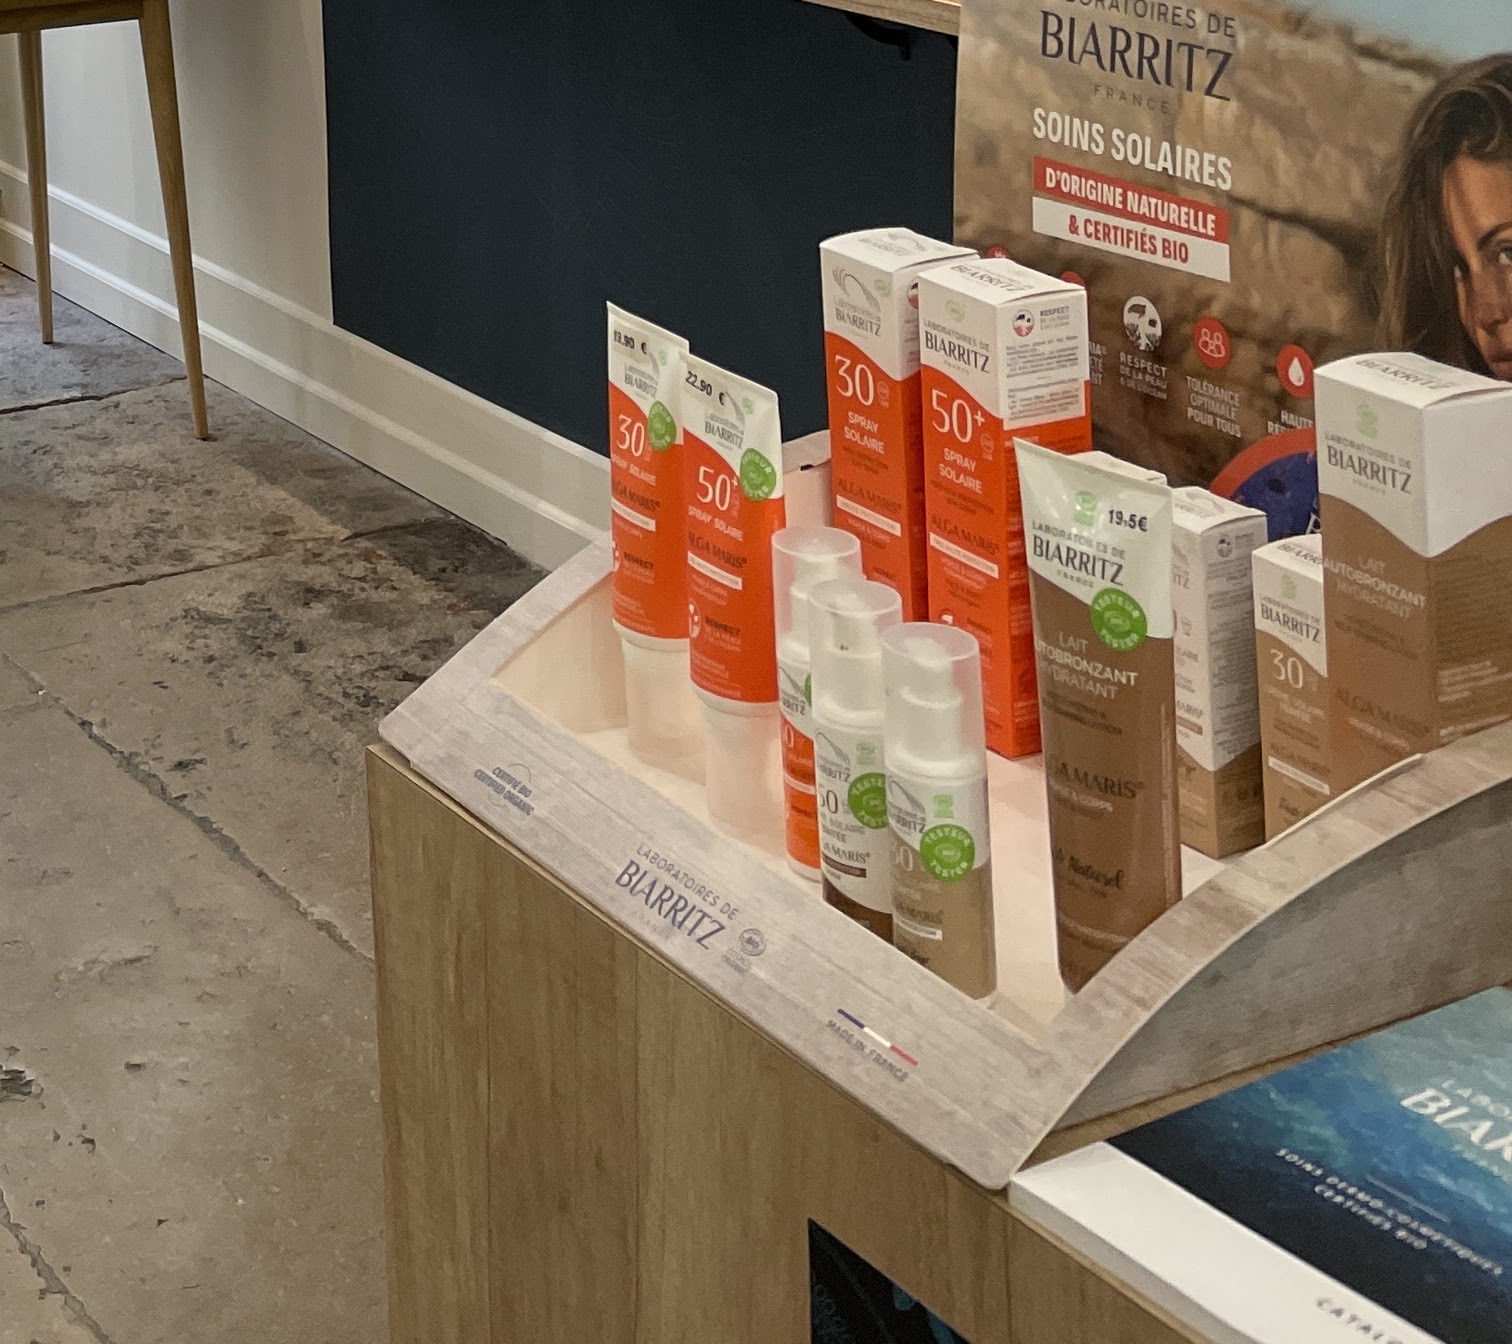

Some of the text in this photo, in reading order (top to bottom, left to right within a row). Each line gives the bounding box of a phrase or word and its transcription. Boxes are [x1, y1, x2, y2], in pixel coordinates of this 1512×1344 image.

[1207, 13, 1236, 39] DE
[1041, 10, 1233, 102] BIARRITZ
[1093, 84, 1170, 112] FRANCE
[1033, 108, 1232, 191] SOINS SOLAIRES
[1045, 167, 1216, 237] D'ORIGINE NATURELLE
[1068, 214, 1189, 264] & CERTIFIÉS BIO
[836, 307, 881, 338] BIARRITZ
[923, 319, 977, 349] LABORATOIRES
[641, 342, 648, 355] €
[924, 330, 990, 375] BIARRITZ
[835, 354, 874, 407] 30
[1120, 352, 1168, 378] RESPECT
[1120, 367, 1168, 389] DE LA PEAU
[685, 371, 726, 406] 22.90 €
[1187, 375, 1240, 406] TOLÉRANCE
[931, 388, 986, 443] 50+
[1188, 407, 1214, 429] POUR
[1216, 416, 1241, 438] TOUS
[1190, 393, 1237, 421] OPTIMALE
[617, 413, 646, 458] 30
[704, 421, 744, 450] BIARRITZ
[847, 411, 880, 435] SPRAY
[844, 427, 885, 455] SOLAIRE
[1325, 431, 1412, 470] LABORATOIRES DE
[943, 447, 977, 473] SPRAY
[1326, 444, 1413, 495] BIARRITZ
[696, 465, 739, 511] 50+
[939, 463, 983, 494] SOLAIRE
[688, 505, 744, 543] SPRAY SOLAIRE
[1032, 533, 1125, 587] BIARRITZ
[1111, 546, 1126, 560] DE
[1358, 555, 1386, 575] LAIT
[1322, 558, 1427, 609] AUTOBRONZANT
[1094, 593, 1140, 618] TESTEUR
[1260, 602, 1321, 644] BIARRITZ
[1059, 631, 1089, 651] LAIT
[1270, 648, 1304, 690] 30
[783, 725, 795, 748] 0
[924, 826, 972, 847] TESTEUR
[636, 842, 740, 921] LABORATOIRES DE
[928, 861, 969, 878] TESTER
[615, 858, 727, 951] BIARRITZ
[826, 1019, 854, 1045] MADE
[865, 1047, 910, 1083] FRANCE
[1275, 1147, 1326, 1178] SOINS
[1394, 1227, 1430, 1251] BIO
